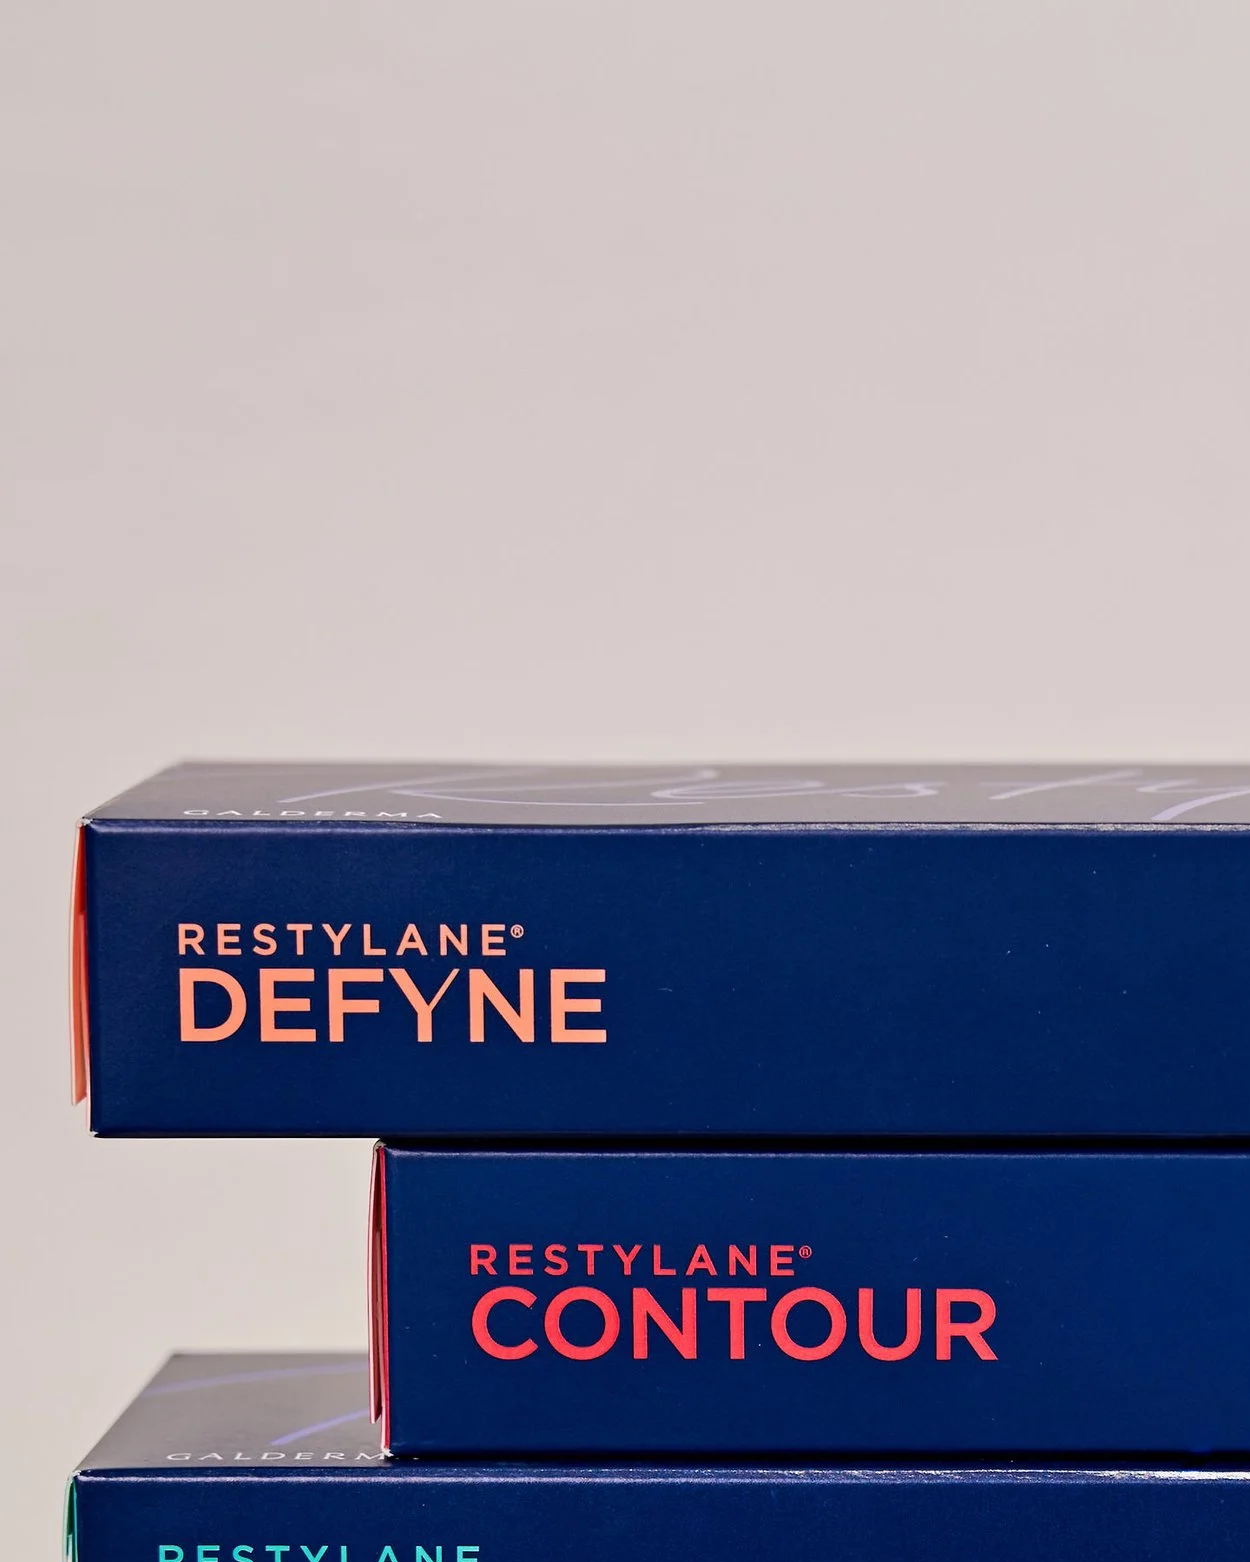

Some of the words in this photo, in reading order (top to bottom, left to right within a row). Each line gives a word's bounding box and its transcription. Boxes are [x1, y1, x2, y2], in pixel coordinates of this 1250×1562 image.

[183, 809, 443, 819] GALDERMA
[178, 967, 608, 1043] DEFYNE
[471, 1286, 999, 1362] CONTOUR
[164, 1451, 419, 1461] GALDERM
